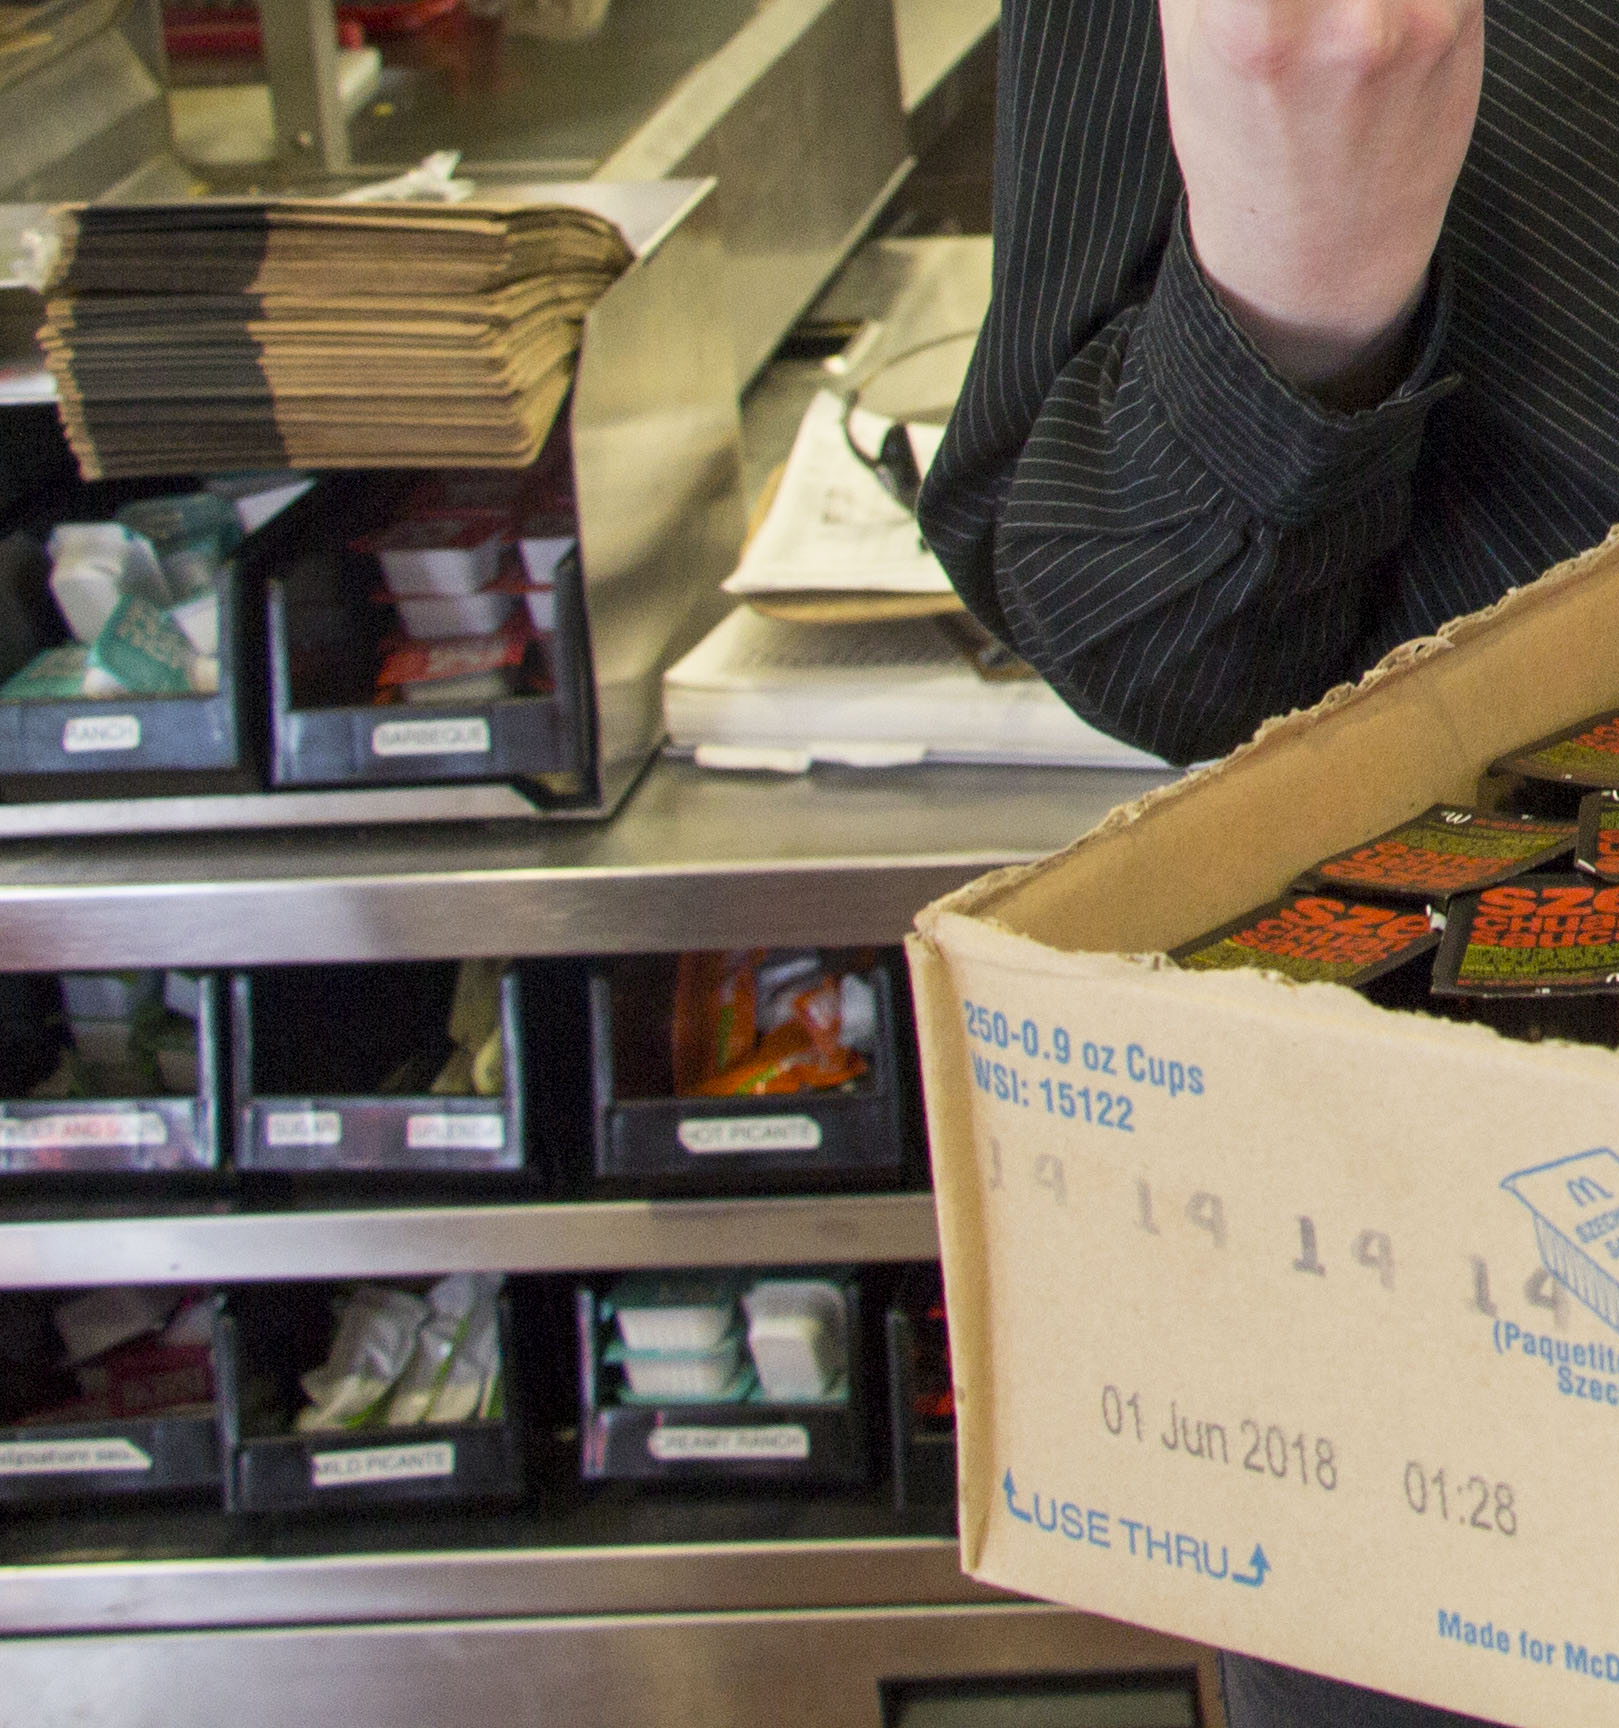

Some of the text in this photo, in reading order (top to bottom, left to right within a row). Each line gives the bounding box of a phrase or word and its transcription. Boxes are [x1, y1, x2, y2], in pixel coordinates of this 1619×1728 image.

[1081, 1041, 1117, 1076] oz
[1126, 1043, 1205, 1098] Cups
[1038, 1077, 1136, 1133] 15122
[1101, 1384, 1519, 1538] 01 Jun 2018 01:28
[1033, 1492, 1230, 1581] USE THRU
[1437, 1608, 1510, 1654] Made
[1517, 1629, 1556, 1667] for
